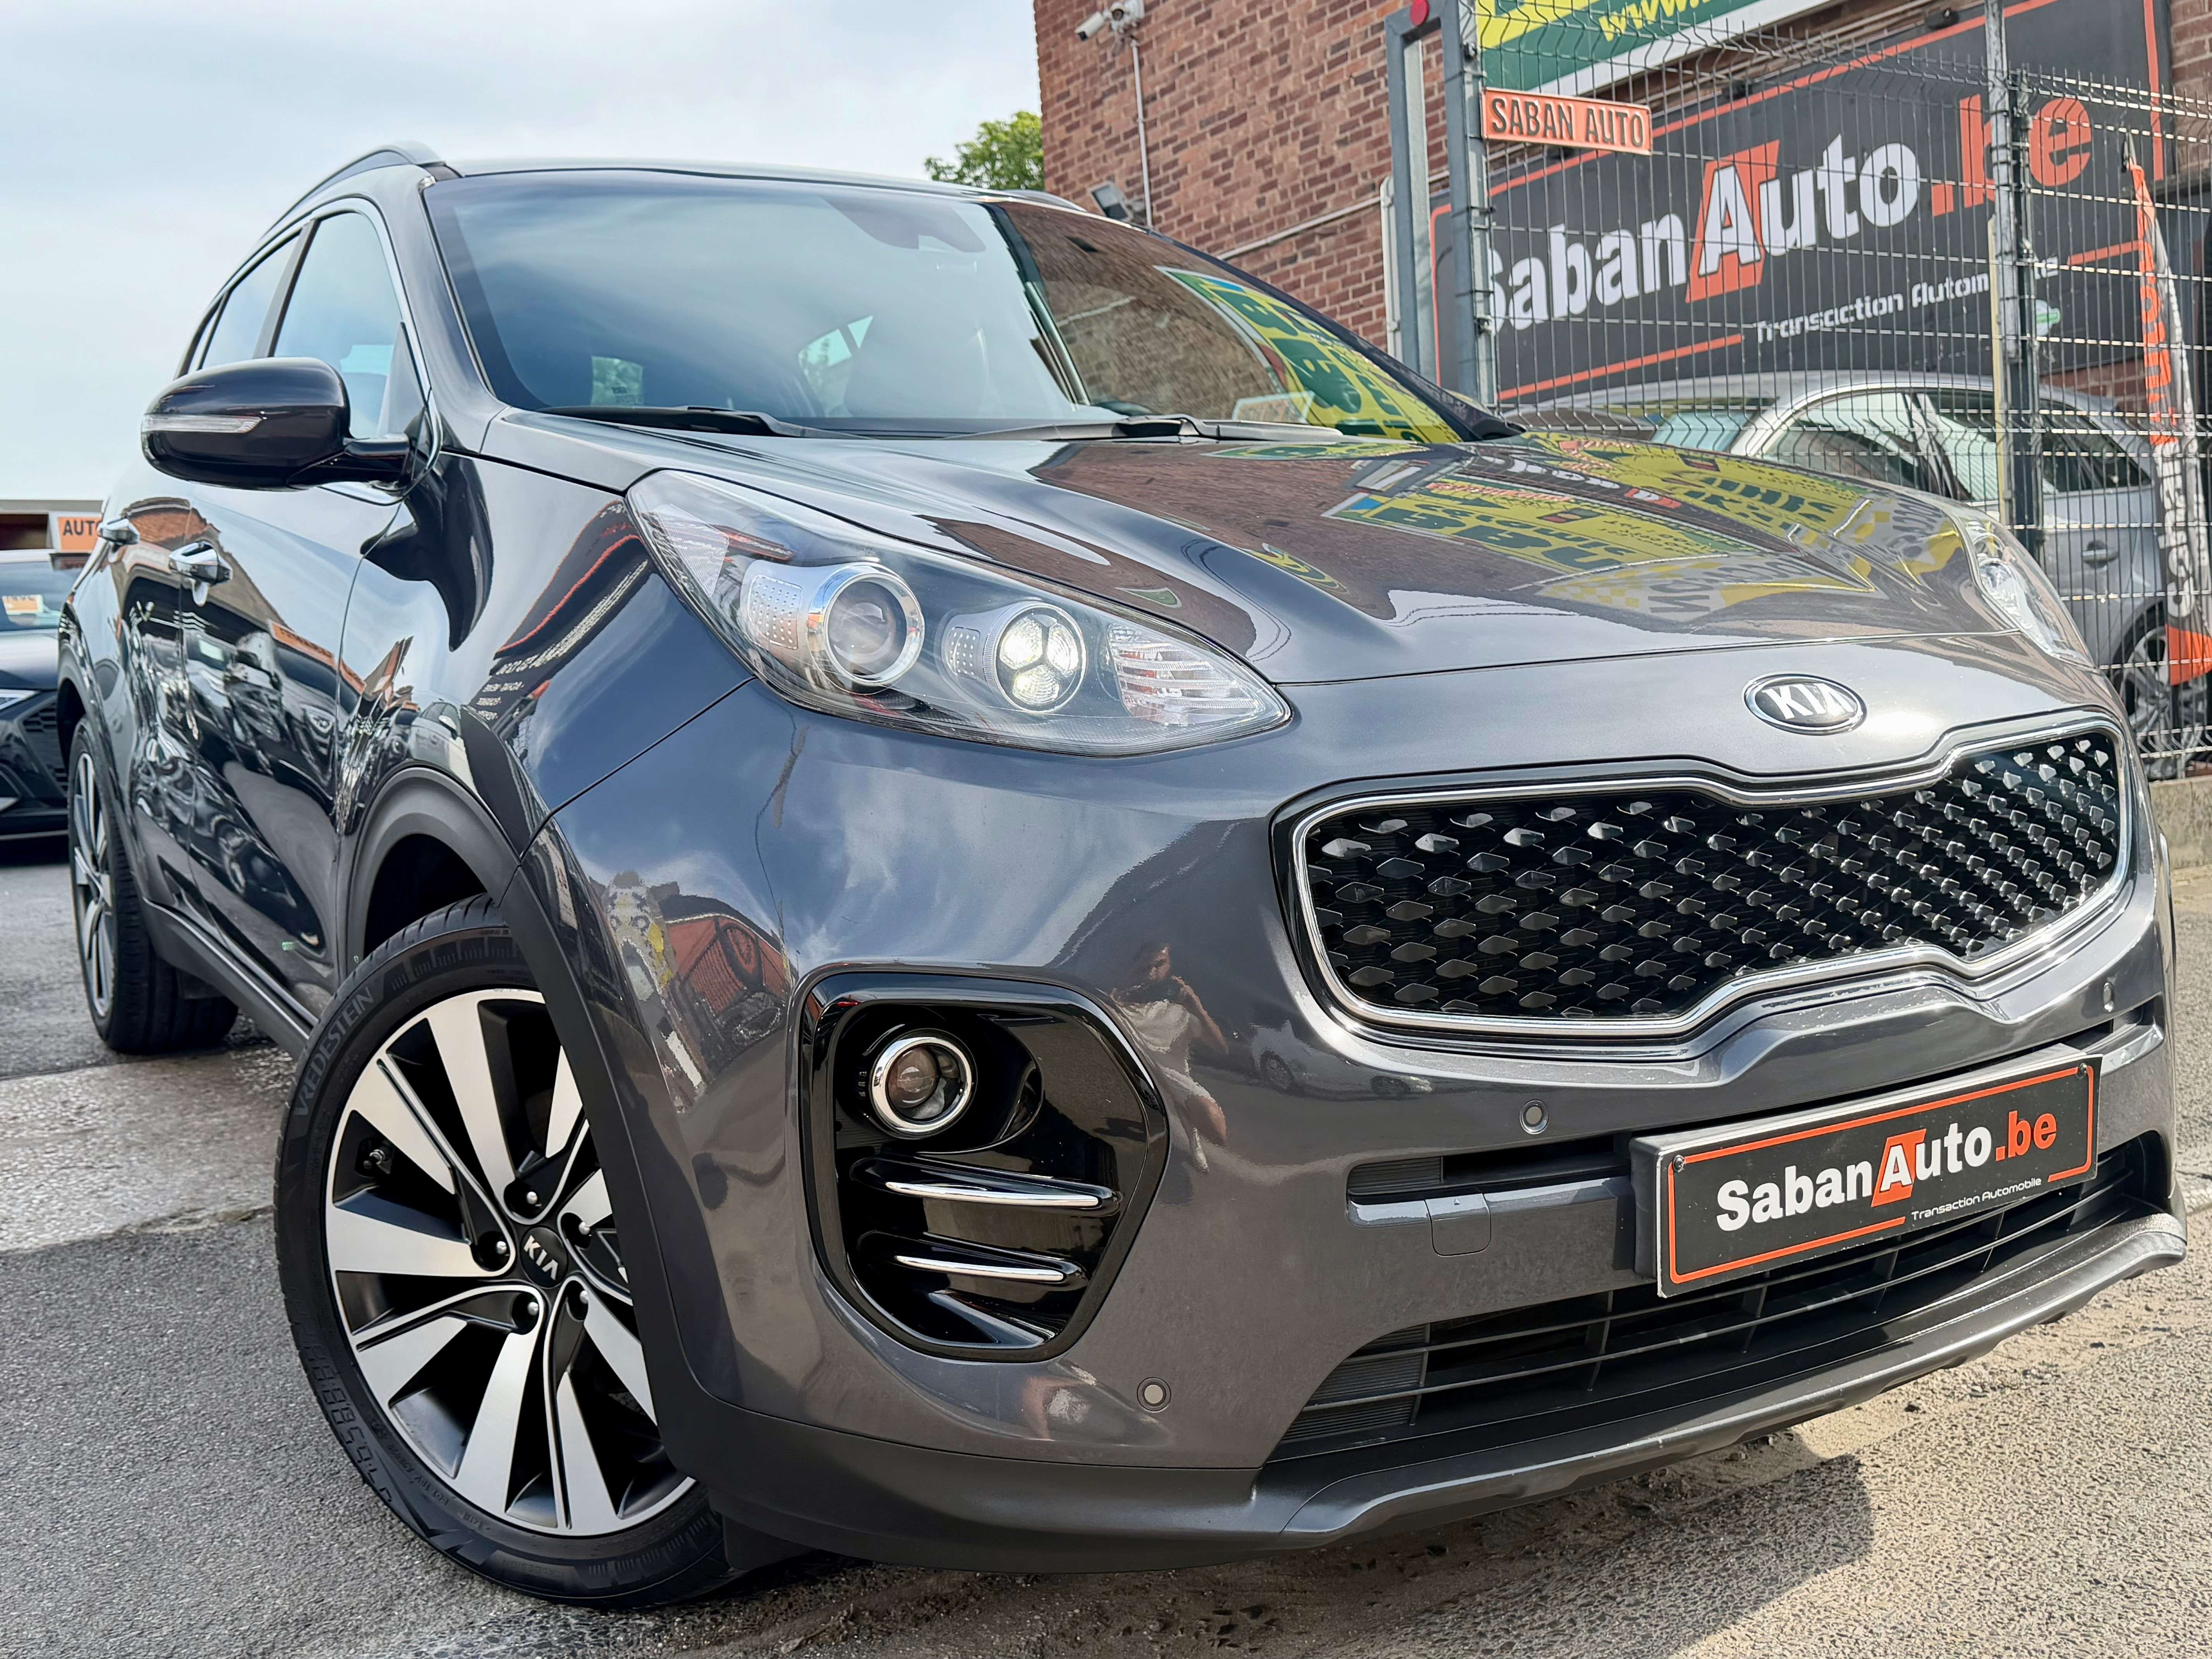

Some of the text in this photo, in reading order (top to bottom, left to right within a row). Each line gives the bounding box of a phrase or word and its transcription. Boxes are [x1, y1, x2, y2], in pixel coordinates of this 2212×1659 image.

[1492, 98, 1644, 148] SABAN AUTO
[1753, 291, 1904, 343] Transaction
[63, 520, 102, 536] AUT
[1762, 683, 1854, 720] KIA
[293, 986, 374, 1118] VREDESTEIN
[1716, 1110, 2057, 1231] SabanAuto.be
[1911, 1177, 2042, 1221] Transaction Automobile
[523, 1235, 558, 1280] KIA
